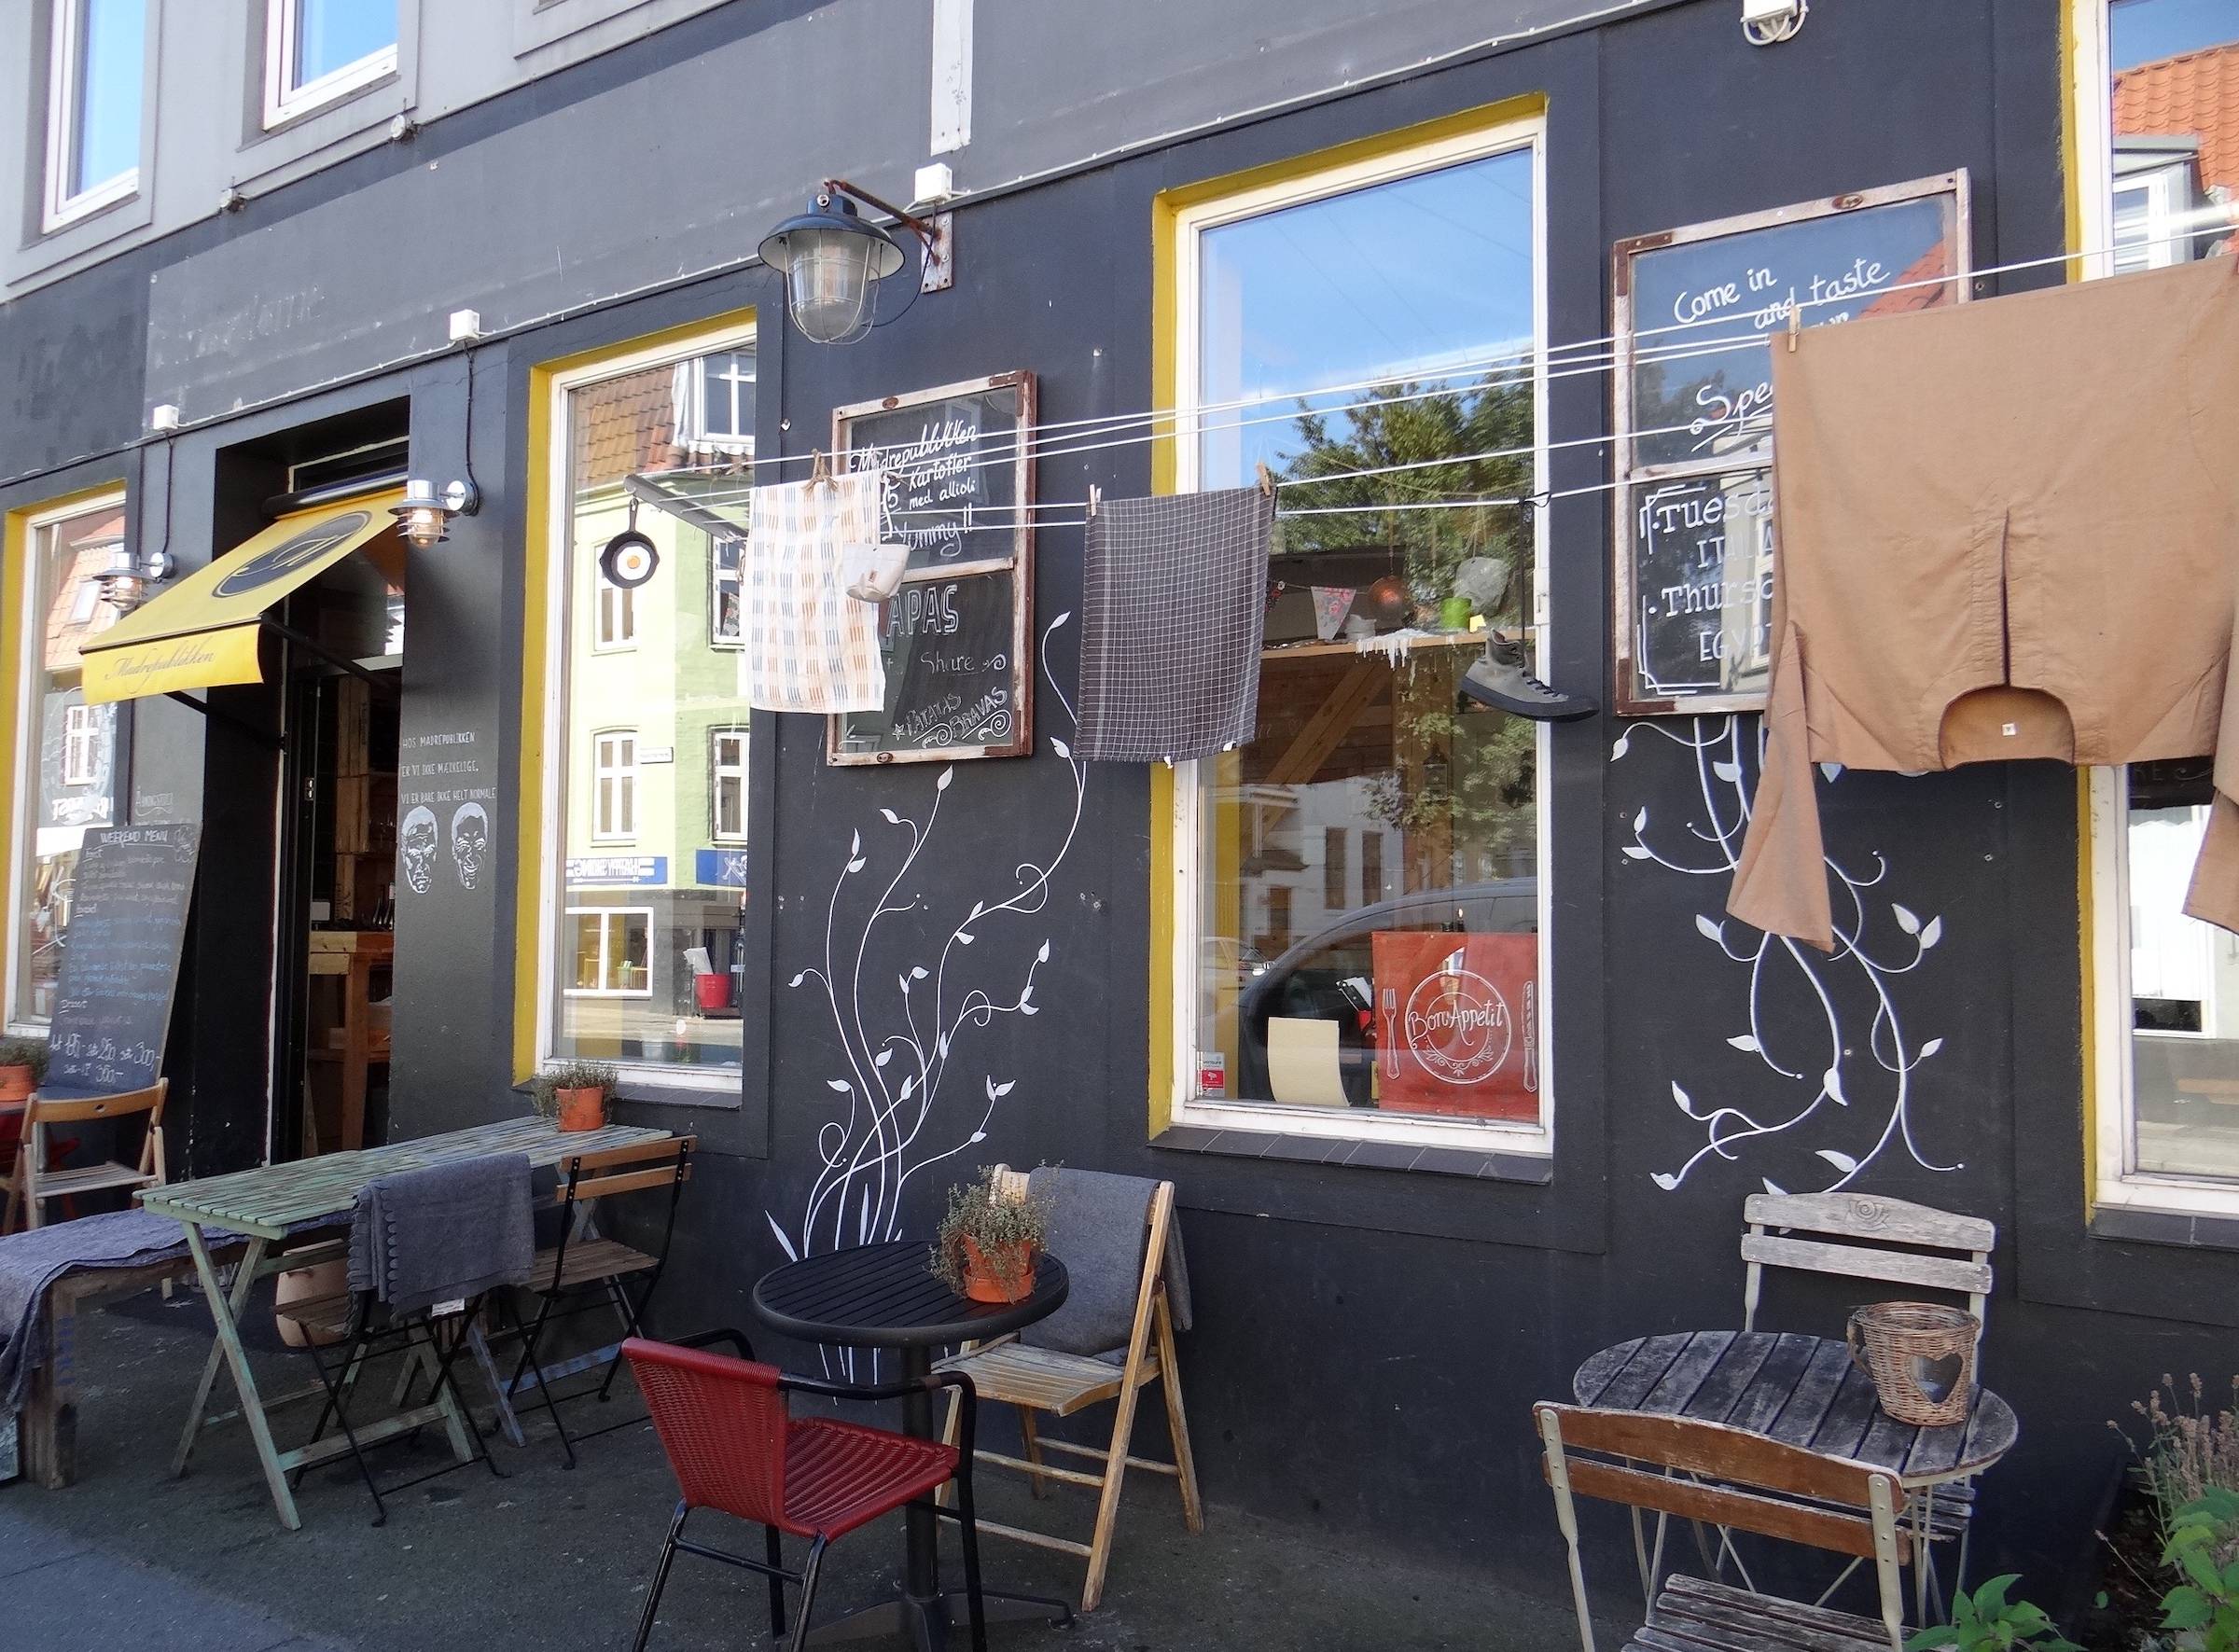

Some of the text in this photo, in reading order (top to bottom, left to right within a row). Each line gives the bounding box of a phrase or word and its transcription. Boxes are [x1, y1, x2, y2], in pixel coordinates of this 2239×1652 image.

[1674, 268, 1777, 324] Come in
[1809, 257, 1891, 305] taste
[1690, 382, 1773, 437] Spe
[909, 477, 975, 510] med allioli
[1699, 623, 1772, 662] EGYP
[1407, 998, 1507, 1050] Bon Appetit
